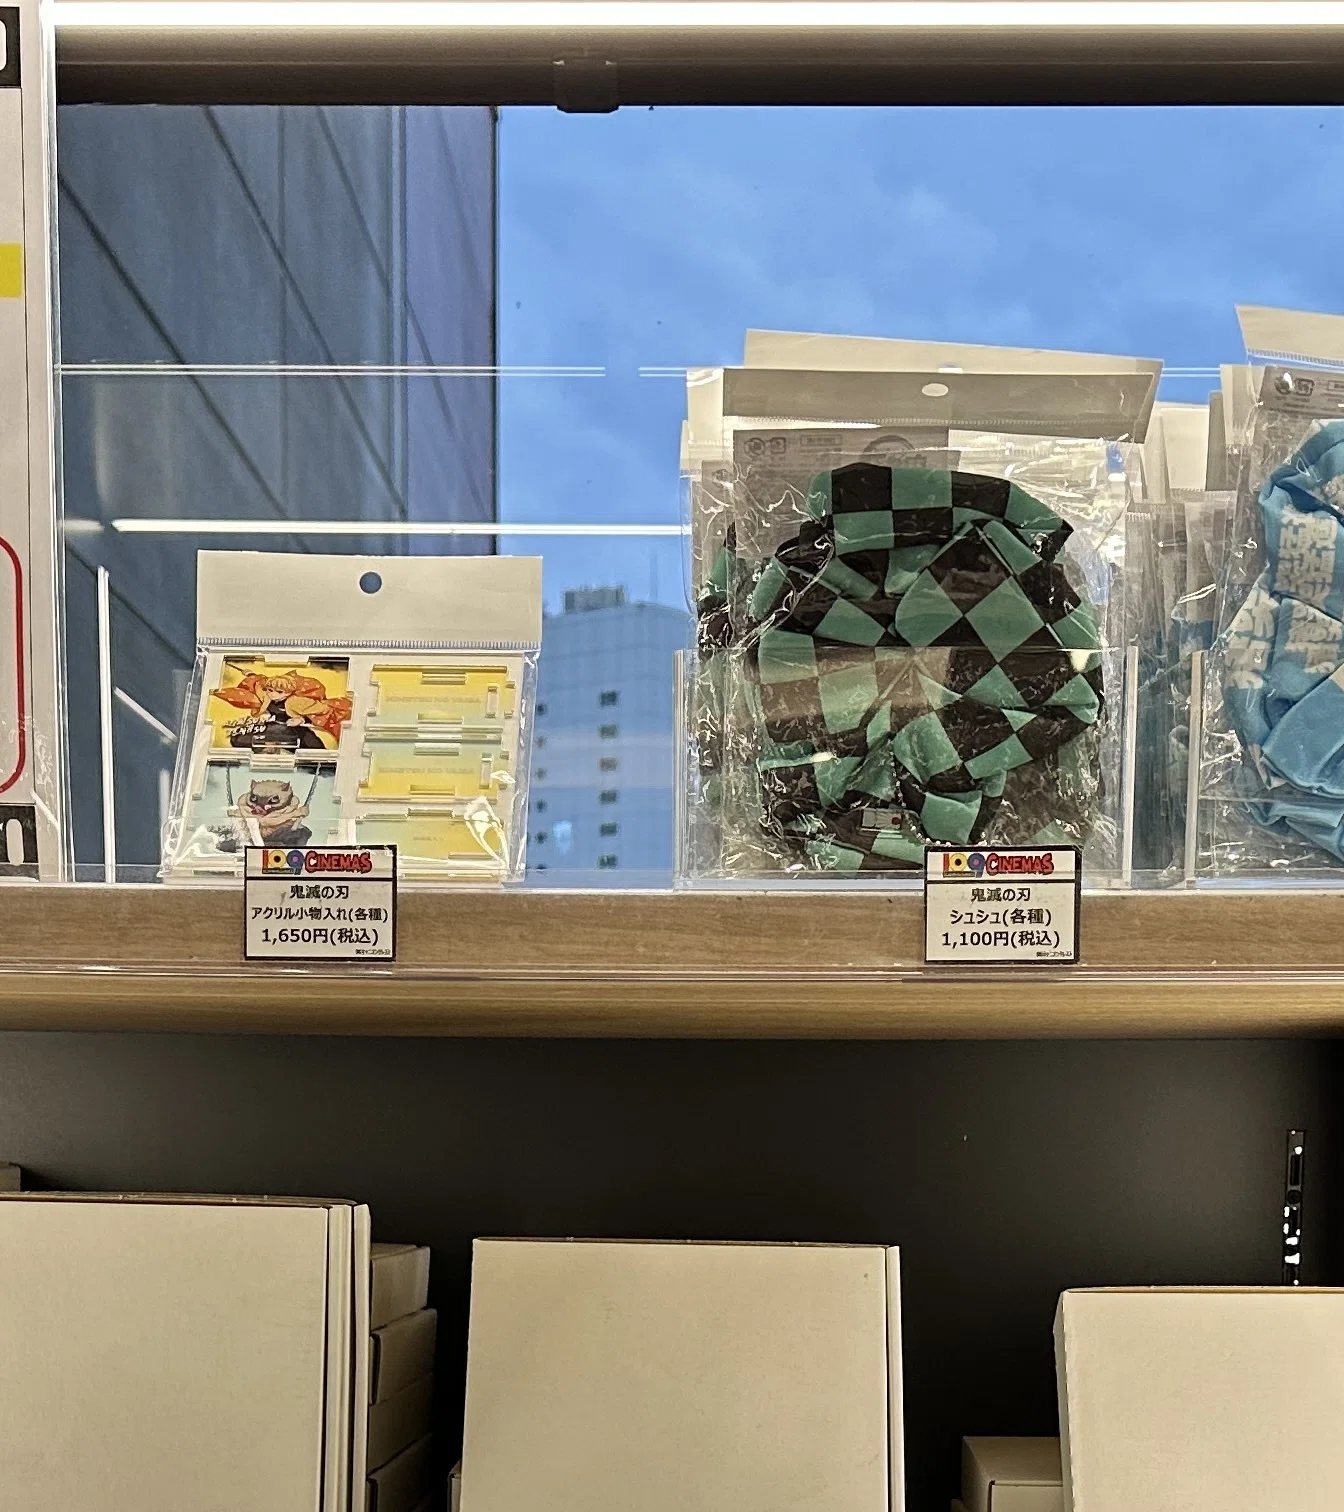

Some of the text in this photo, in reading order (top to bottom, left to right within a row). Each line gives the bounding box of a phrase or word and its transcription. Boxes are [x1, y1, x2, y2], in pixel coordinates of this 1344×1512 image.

[305, 850, 373, 874] CINEMAS
[985, 852, 1055, 876] CINEMAS
[289, 885, 350, 900] 鬼滅の刃
[971, 888, 1031, 902] 鬼滅の刃
[251, 907, 389, 923] アクリル小物入れ(各種)
[950, 908, 1052, 927] シュシュ(各種)
[262, 928, 379, 946] 1,650円(税込)
[942, 931, 1060, 949] 1,100円(税込)
